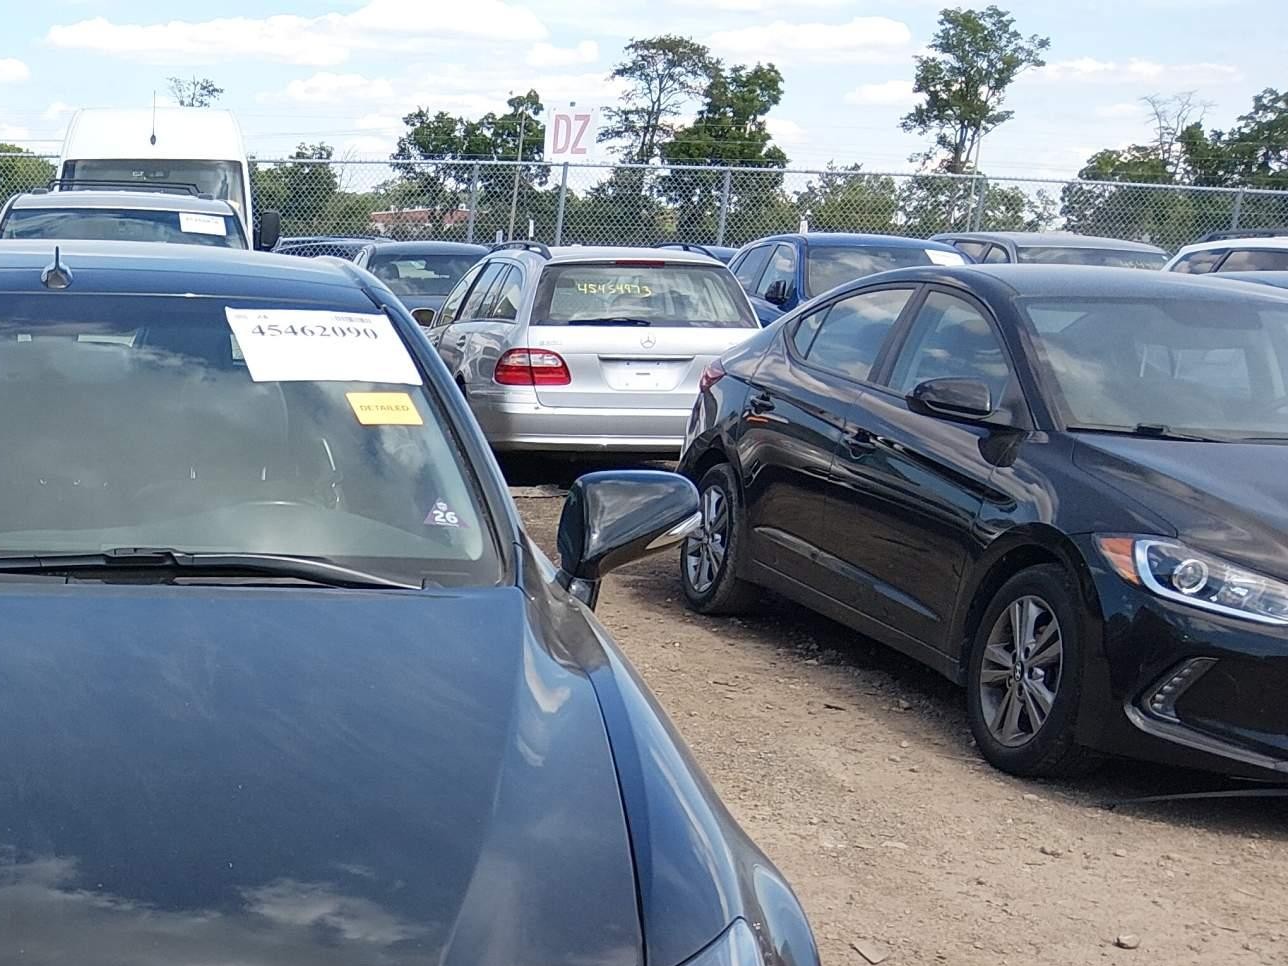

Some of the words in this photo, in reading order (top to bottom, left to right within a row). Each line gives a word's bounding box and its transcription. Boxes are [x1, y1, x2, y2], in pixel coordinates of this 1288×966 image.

[552, 114, 591, 155] DZ
[251, 324, 379, 340] 45462090
[432, 510, 459, 524] 26
